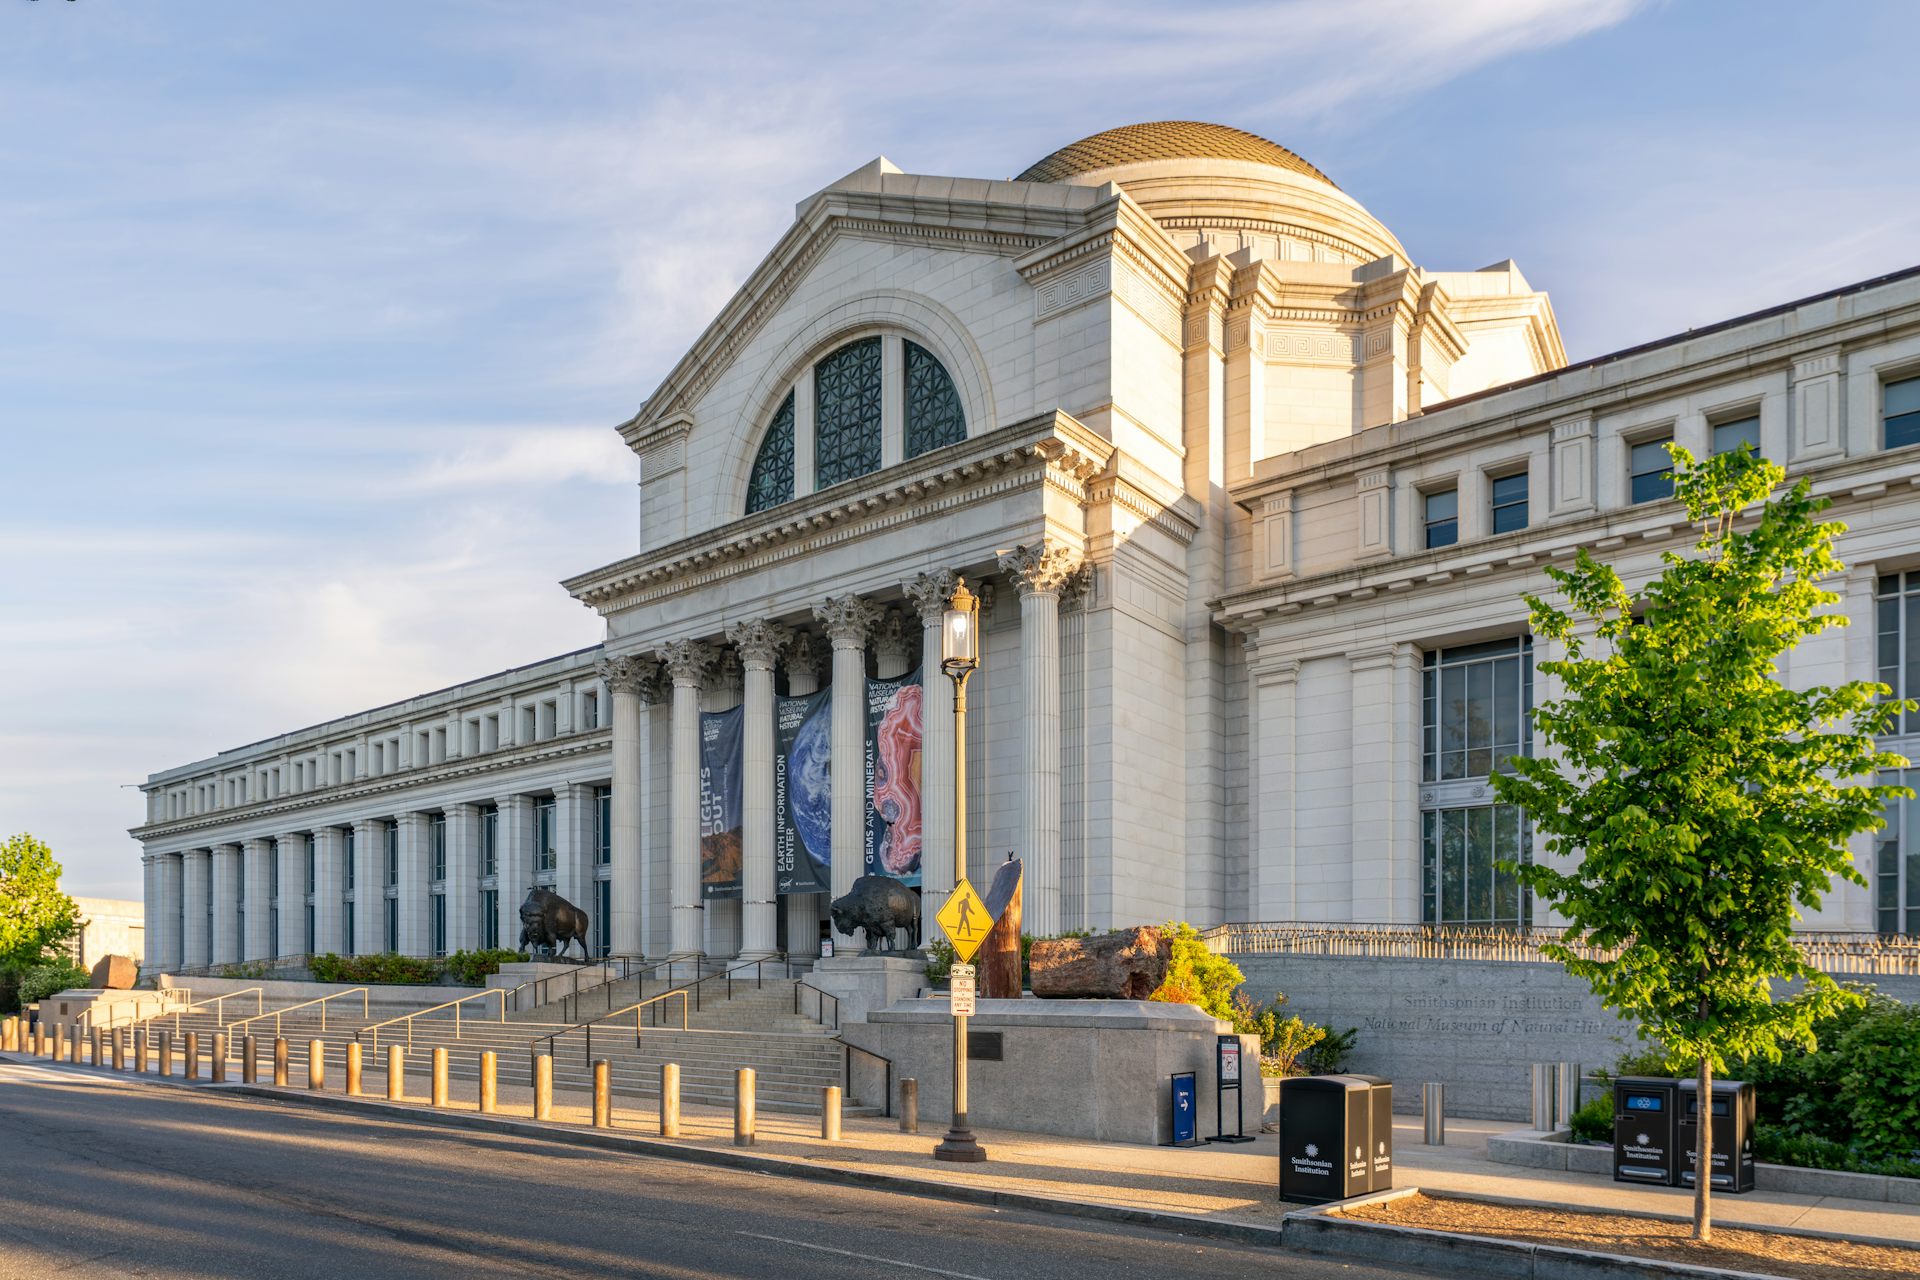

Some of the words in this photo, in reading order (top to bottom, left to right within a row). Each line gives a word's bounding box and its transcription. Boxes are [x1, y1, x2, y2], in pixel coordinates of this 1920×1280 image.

[779, 720, 801, 730] HISTORY
[865, 740, 875, 798] MINERALS
[701, 767, 713, 838] LIGHTS
[777, 755, 785, 833] INFORMATION
[713, 793, 724, 835] OUT
[865, 801, 874, 827] AND
[777, 836, 786, 872] EARTH
[786, 828, 794, 871] CENTER
[865, 830, 874, 864] GEMS
[1404, 994, 1496, 1009] Smithsonian
[1502, 995, 1583, 1010] Institution
[1424, 1018, 1487, 1032] Museum
[1491, 1018, 1509, 1034] of
[1511, 1019, 1569, 1033] Natural
[1622, 1144, 1663, 1154] Smithsonian
[1626, 1151, 1660, 1161] Institution
[1291, 1156, 1333, 1169] Smithsonian
[1295, 1165, 1329, 1176] Institution
